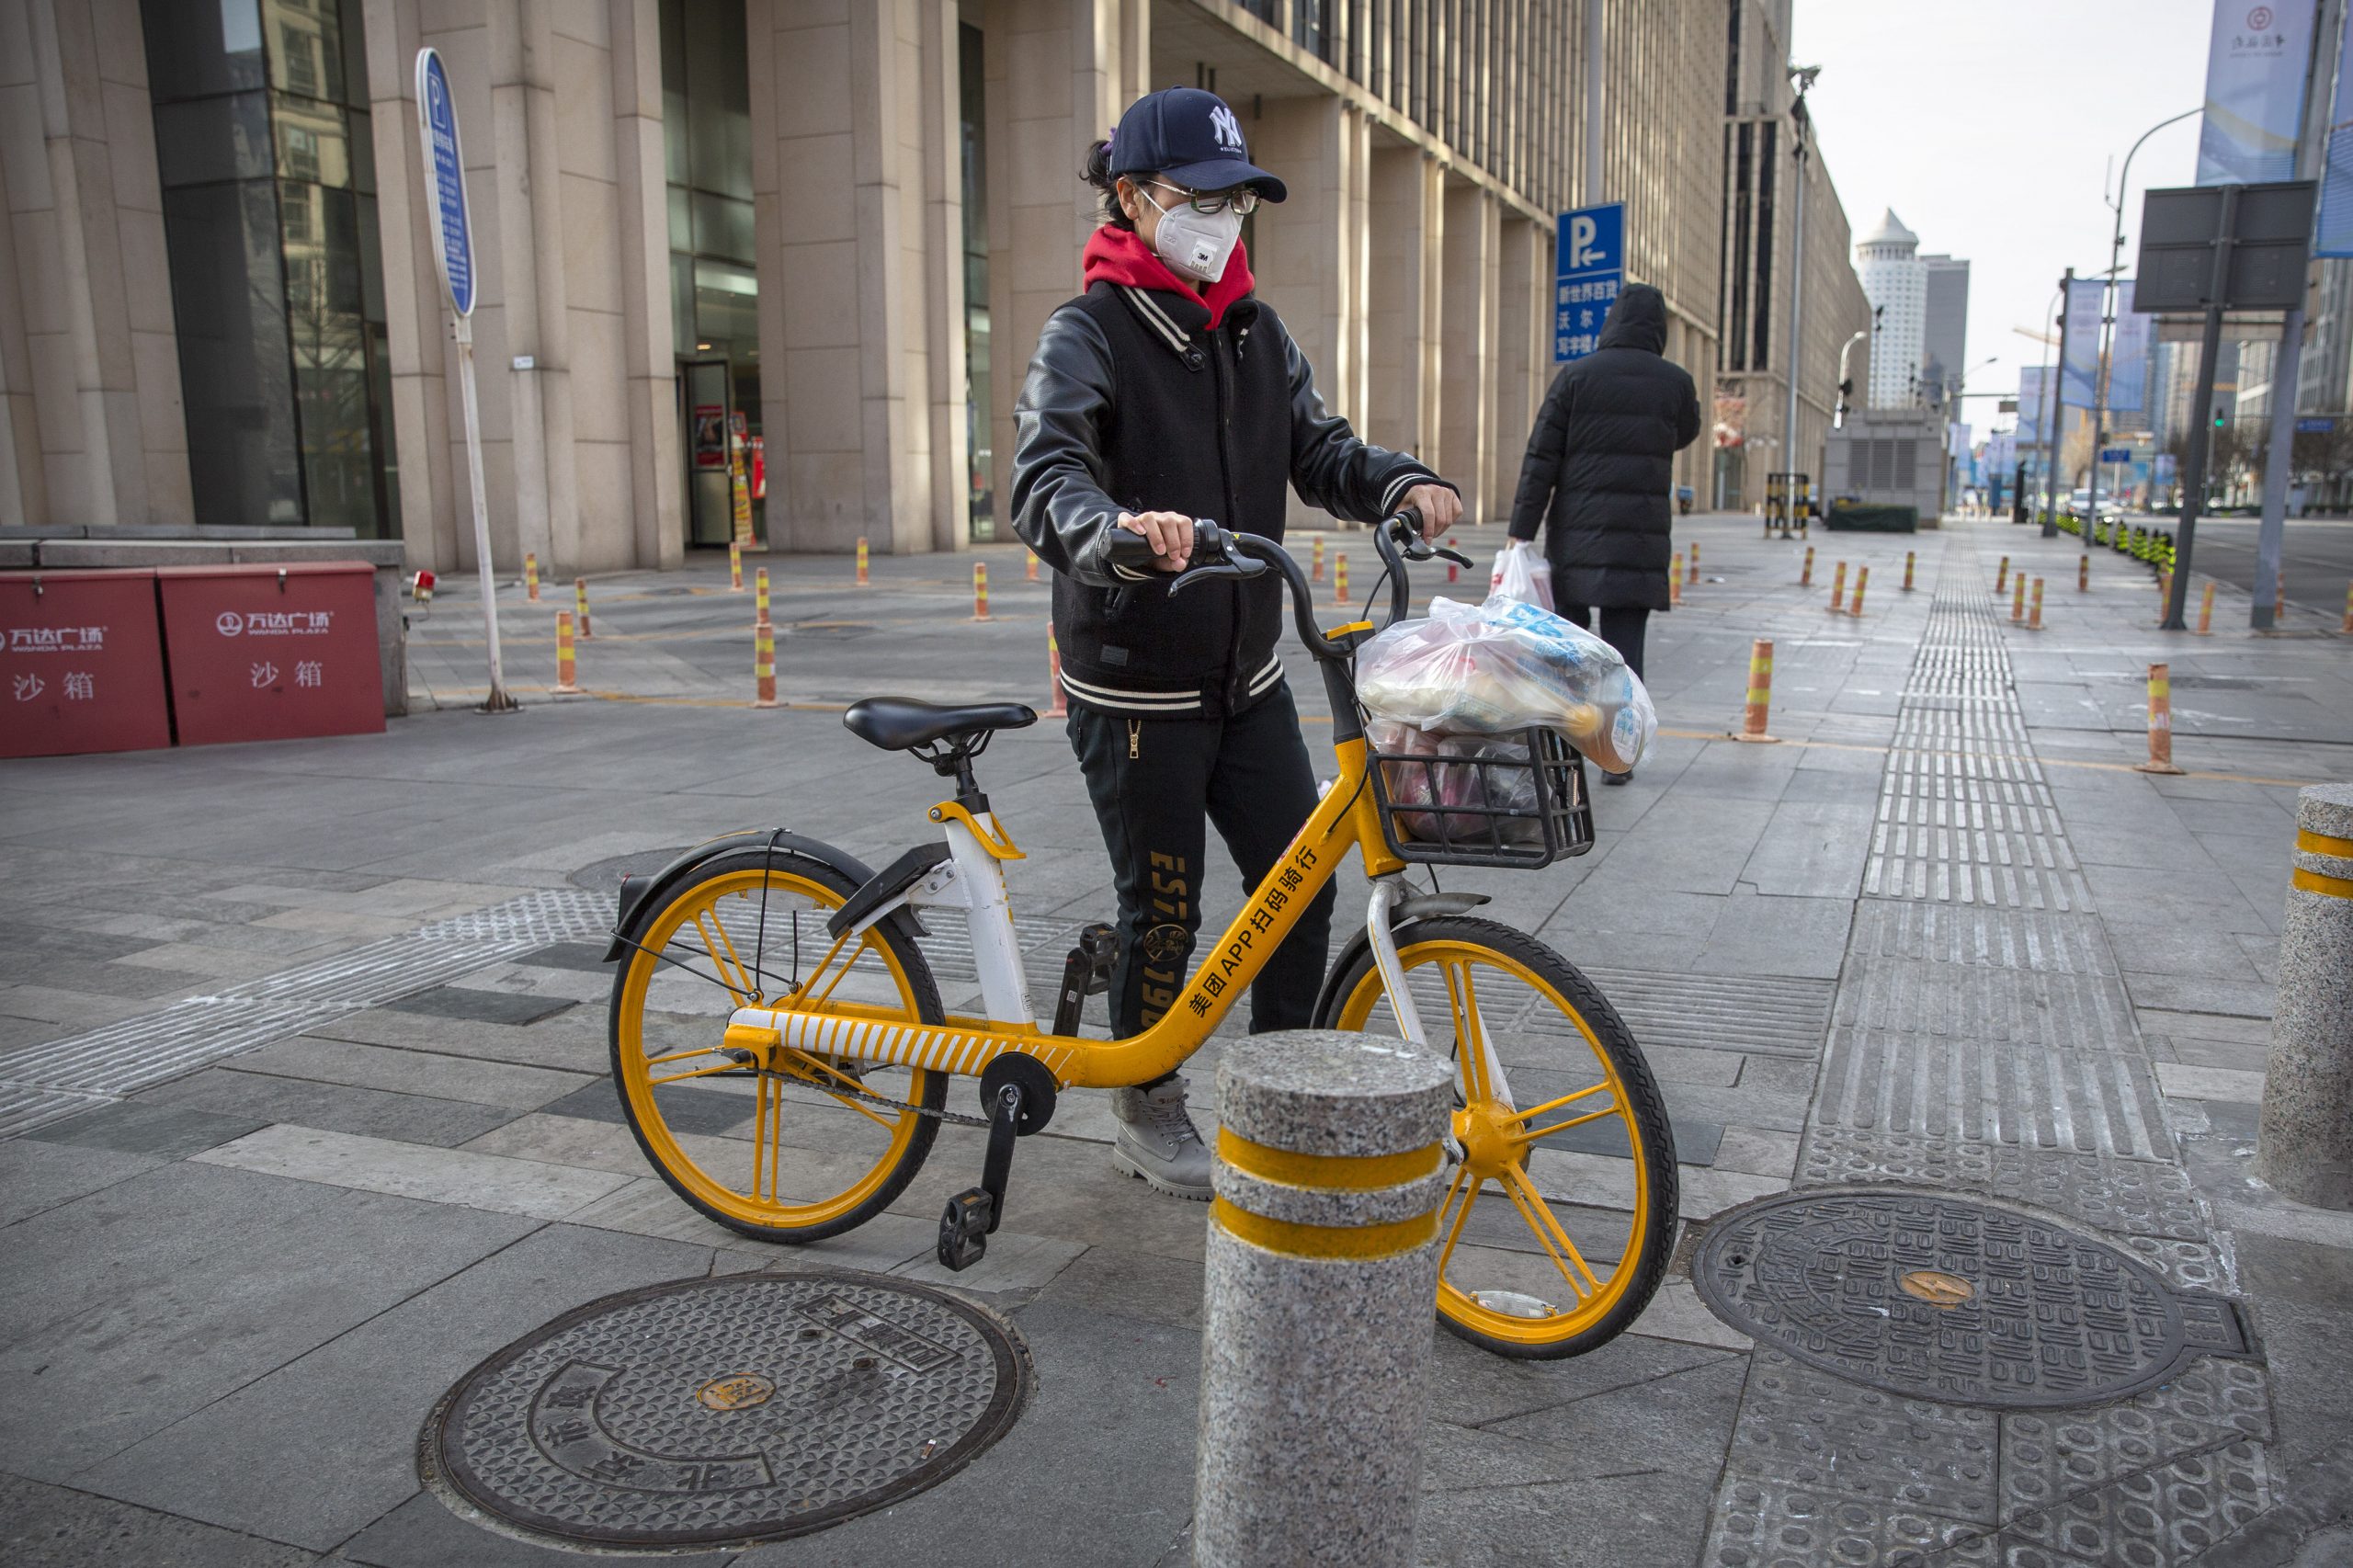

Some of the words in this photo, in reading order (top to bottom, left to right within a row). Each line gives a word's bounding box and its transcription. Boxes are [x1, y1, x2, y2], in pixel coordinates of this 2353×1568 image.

[1209, 106, 1243, 146] NY
[1570, 216, 1597, 268] P
[1198, 252, 1209, 262] 3M
[1558, 279, 1620, 305] 新世界百货
[246, 611, 330, 628] 万达广场
[247, 628, 290, 636] WANDA
[8, 627, 104, 645] 万达广场
[12, 644, 58, 653] WANDA
[12, 672, 95, 702] 沙箱
[250, 660, 323, 689] 沙箱
[1188, 845, 1318, 1018] 美团APP扫码骑行
